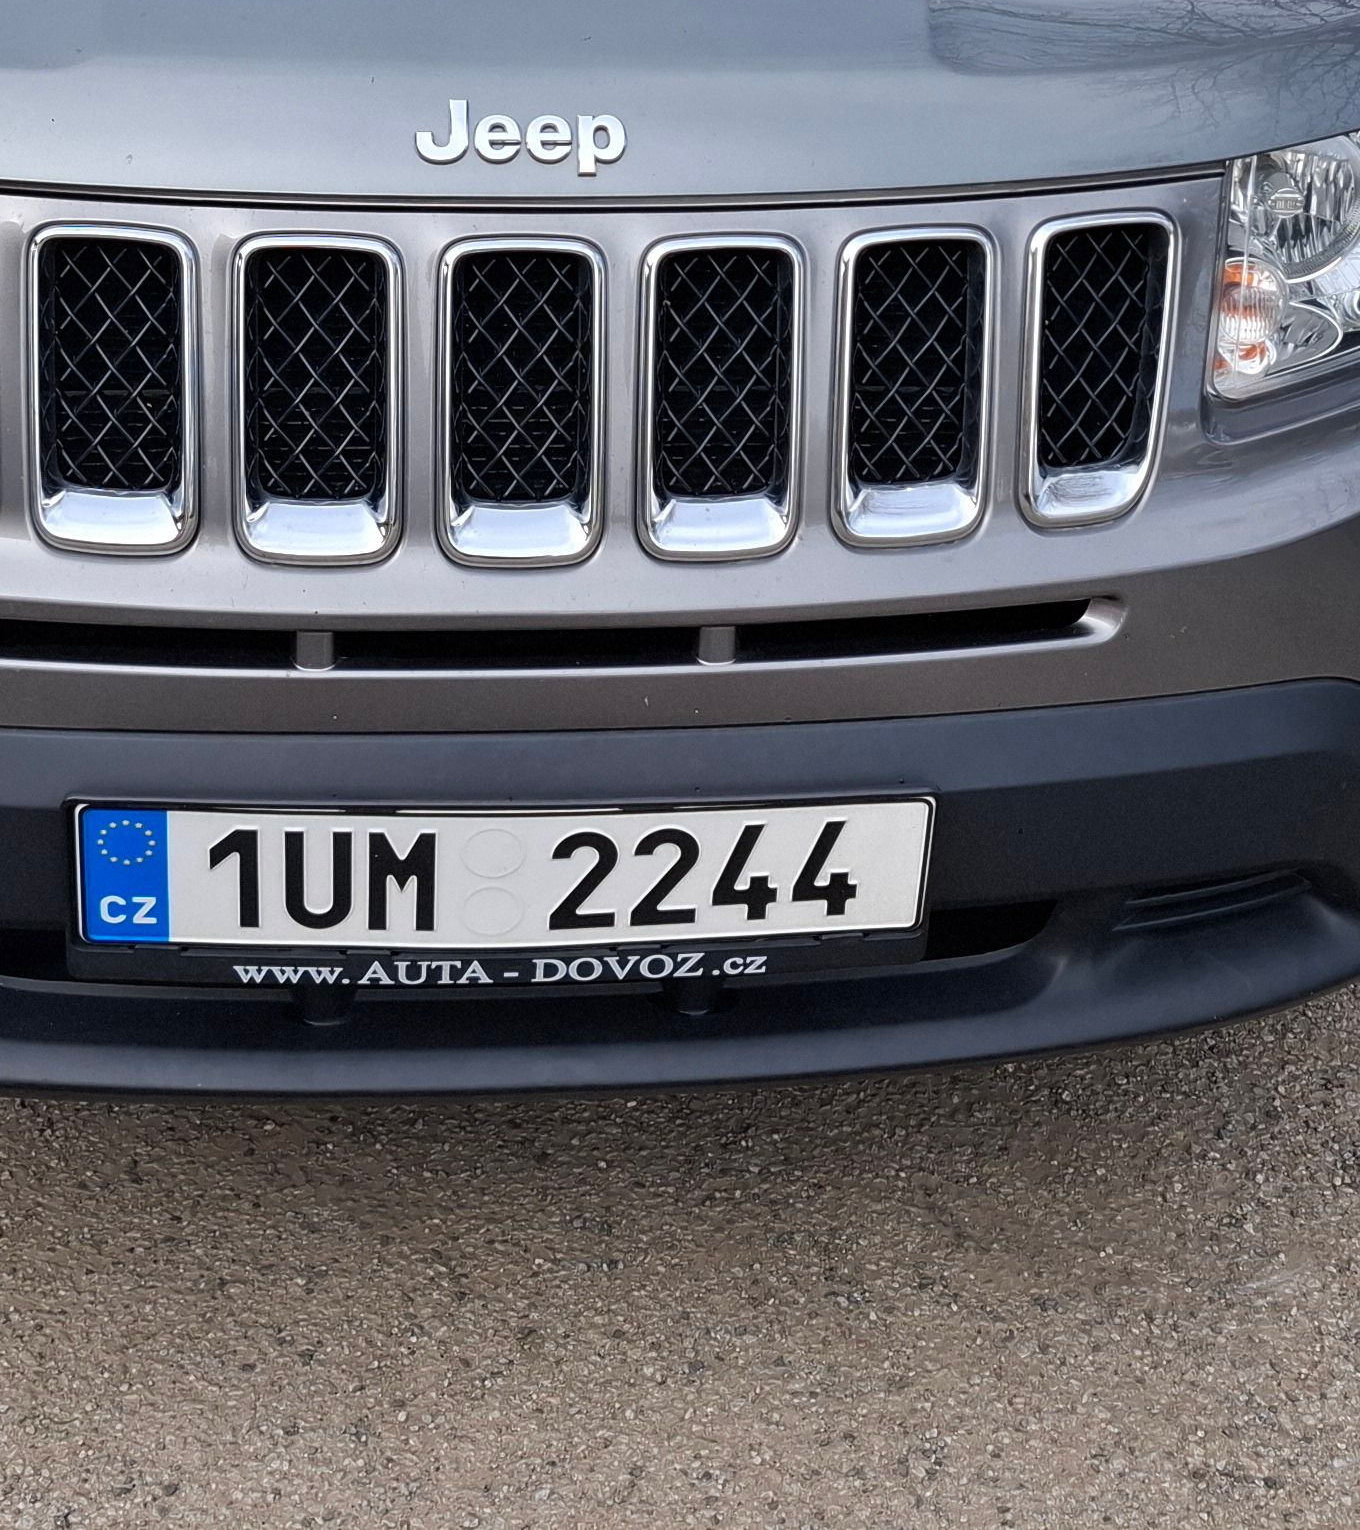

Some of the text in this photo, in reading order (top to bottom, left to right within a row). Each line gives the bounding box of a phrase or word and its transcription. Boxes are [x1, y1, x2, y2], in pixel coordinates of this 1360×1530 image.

[414, 99, 627, 177] Jeep
[99, 895, 158, 925] CZ
[209, 821, 858, 931] 1UM 2244
